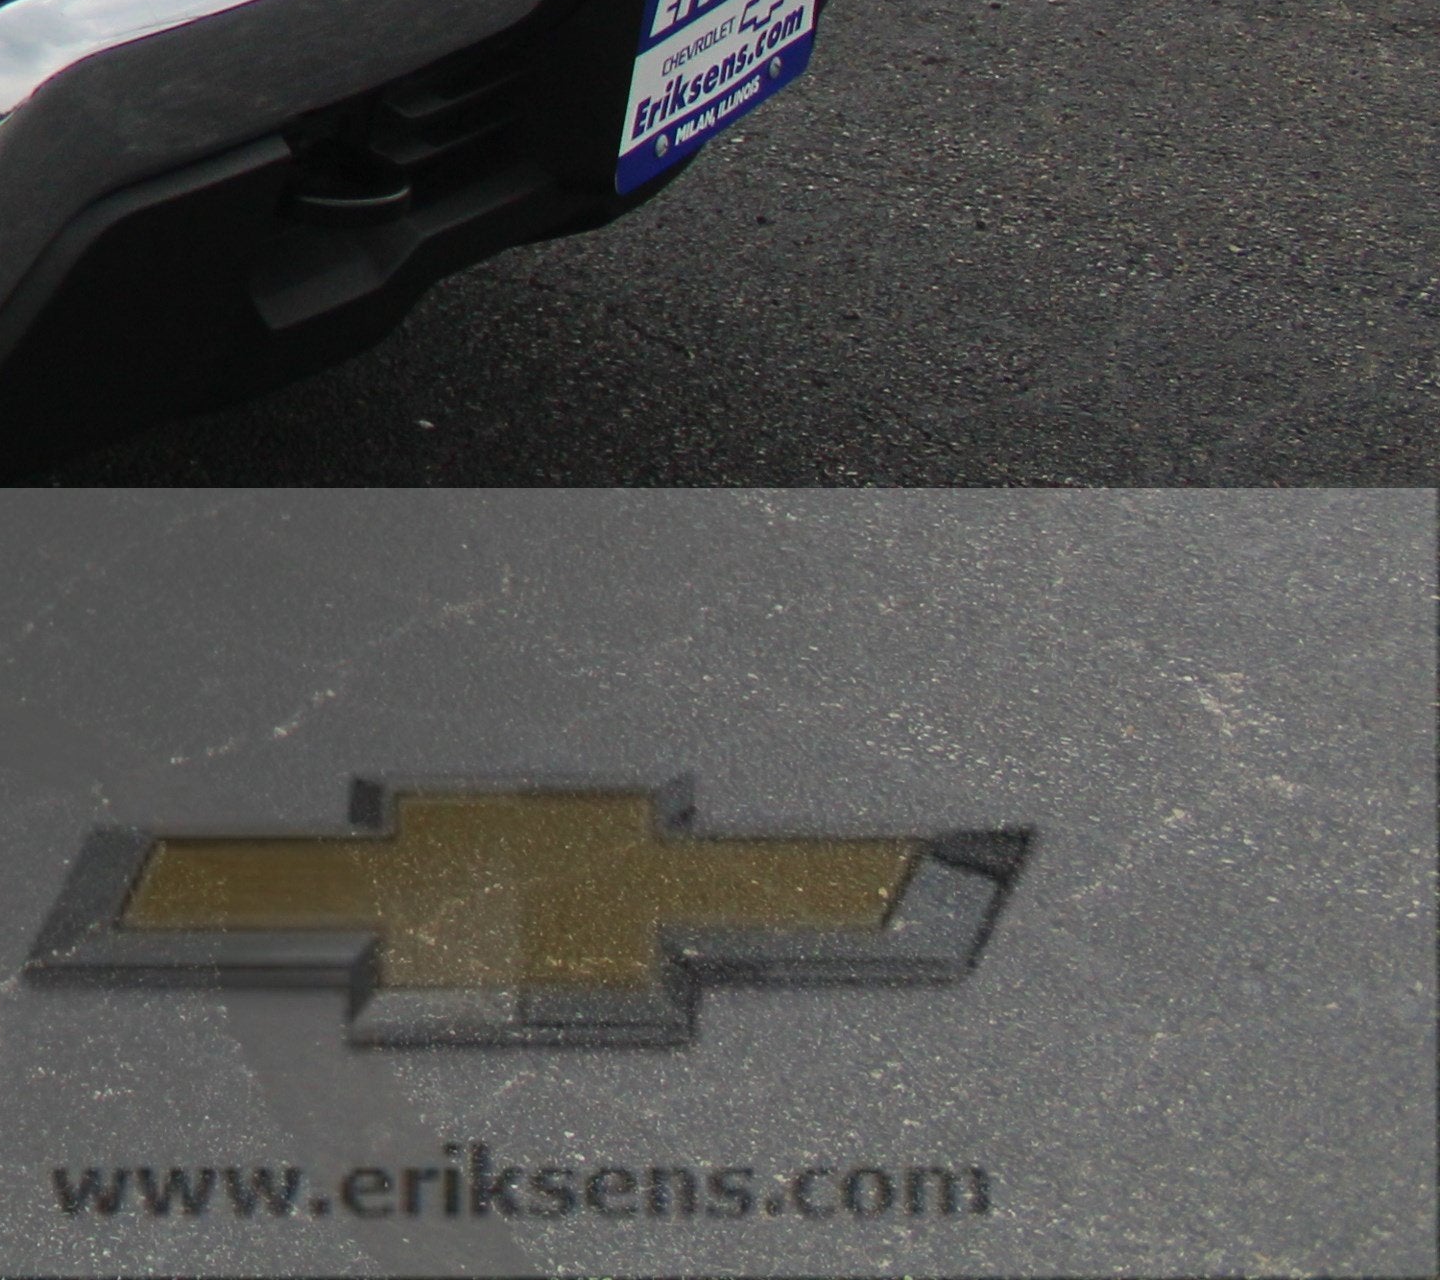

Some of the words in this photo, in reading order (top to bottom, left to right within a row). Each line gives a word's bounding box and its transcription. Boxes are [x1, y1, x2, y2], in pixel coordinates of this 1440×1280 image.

[631, 5, 804, 140] Eriksens.com
[661, 16, 736, 77] CHEVROLET
[717, 74, 761, 120] ILLINOIS
